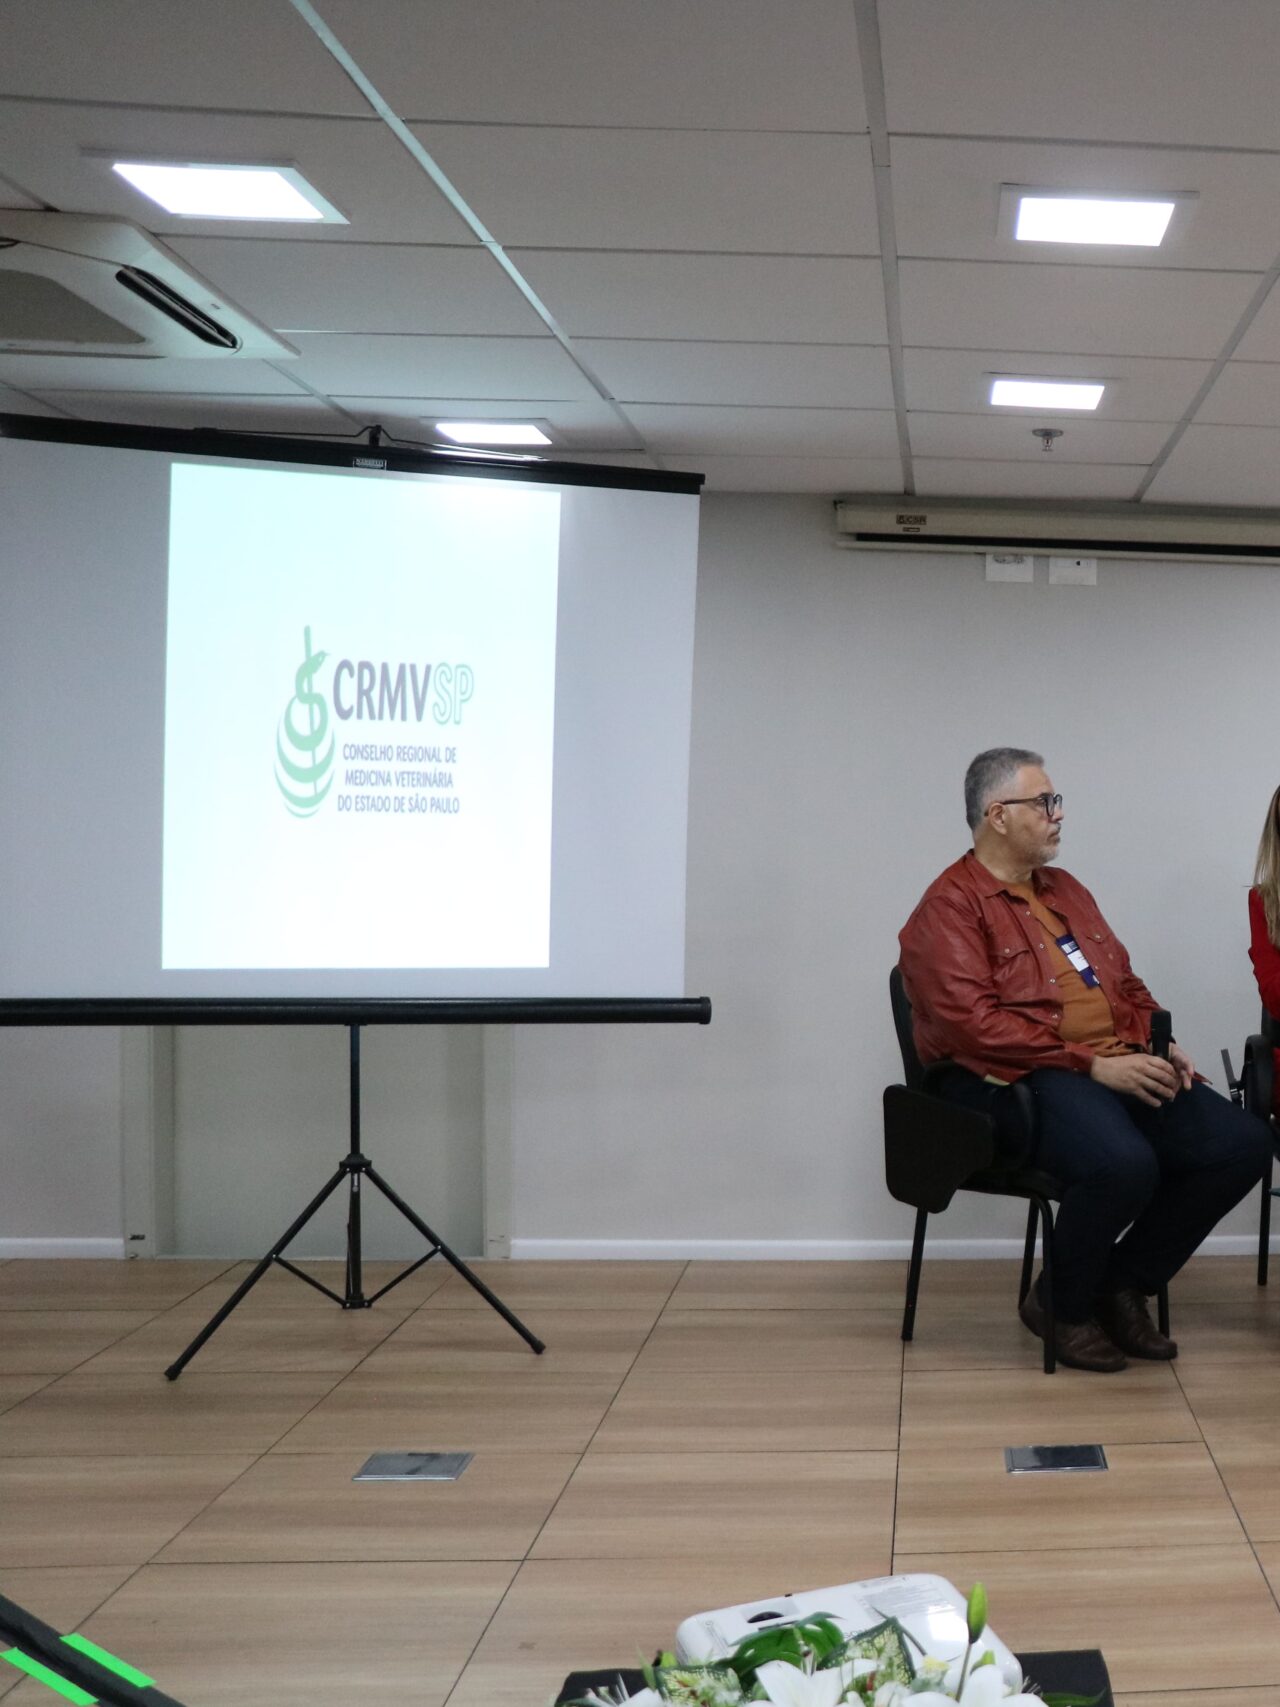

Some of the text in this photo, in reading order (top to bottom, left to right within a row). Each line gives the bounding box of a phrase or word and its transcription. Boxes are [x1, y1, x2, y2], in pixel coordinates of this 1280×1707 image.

[343, 744, 456, 763] CONSELHO REGIONAL DE
[345, 768, 453, 788] MEDICINA VETERINÁRIA
[338, 793, 460, 814] DO ESTADO DE SÃO PAULO
